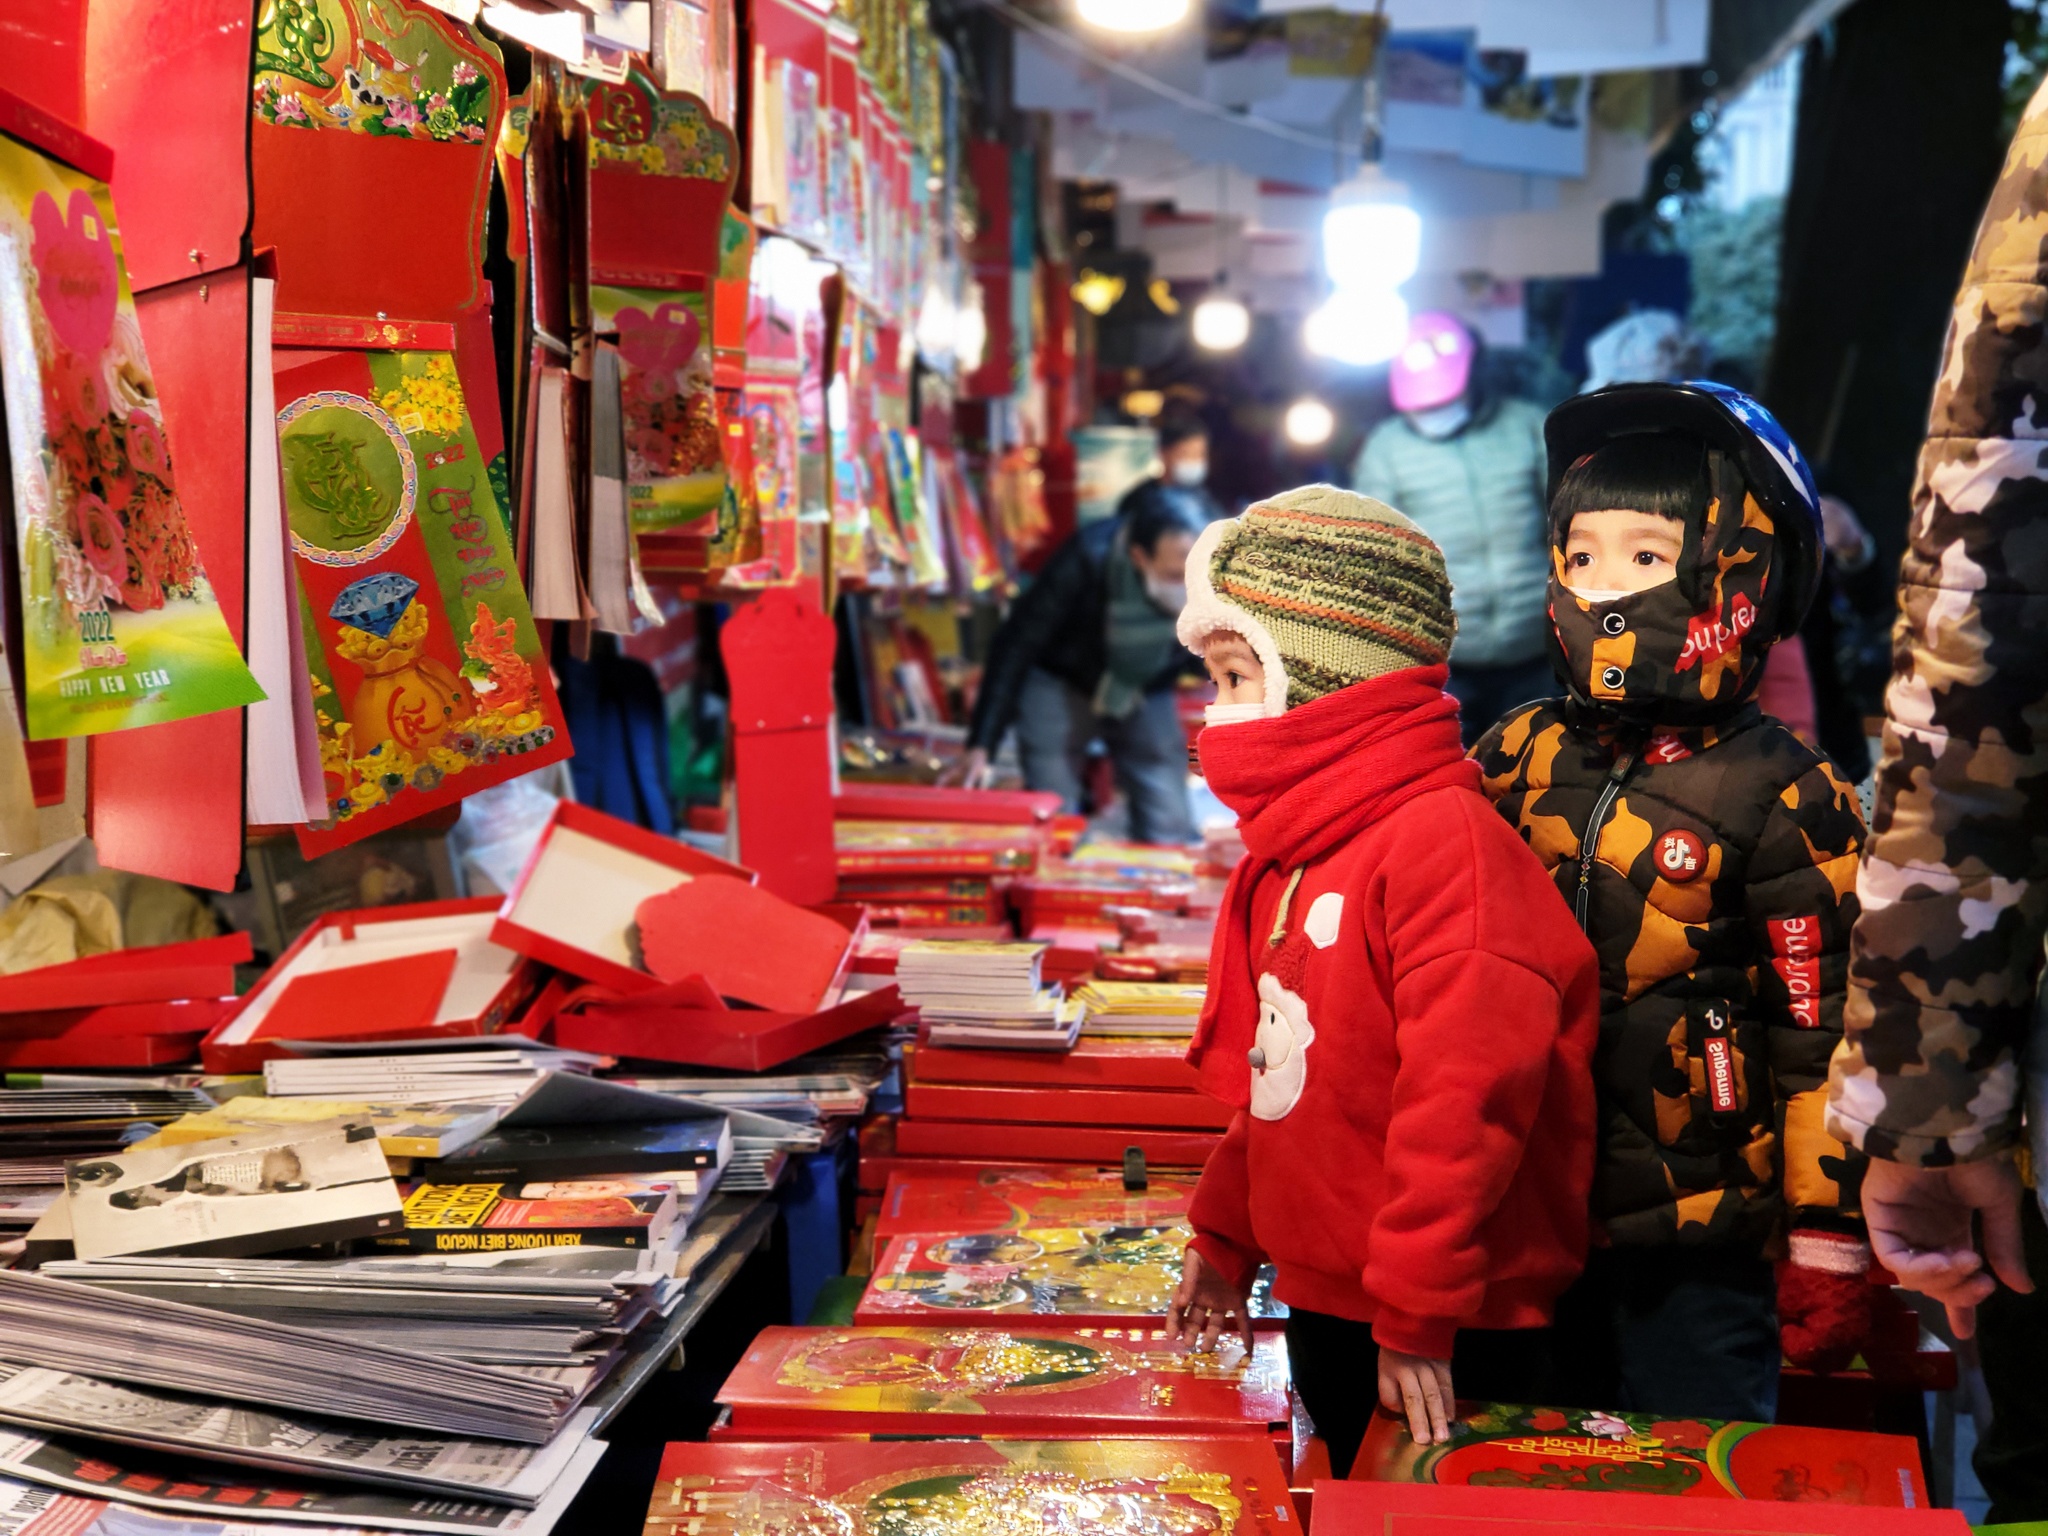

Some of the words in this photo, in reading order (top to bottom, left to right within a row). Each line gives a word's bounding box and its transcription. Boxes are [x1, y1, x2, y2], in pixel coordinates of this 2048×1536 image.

[78, 611, 115, 642] 2022
[60, 678, 92, 698] HAPPY
[99, 675, 126, 694] NEW
[133, 669, 171, 689] YEAR
